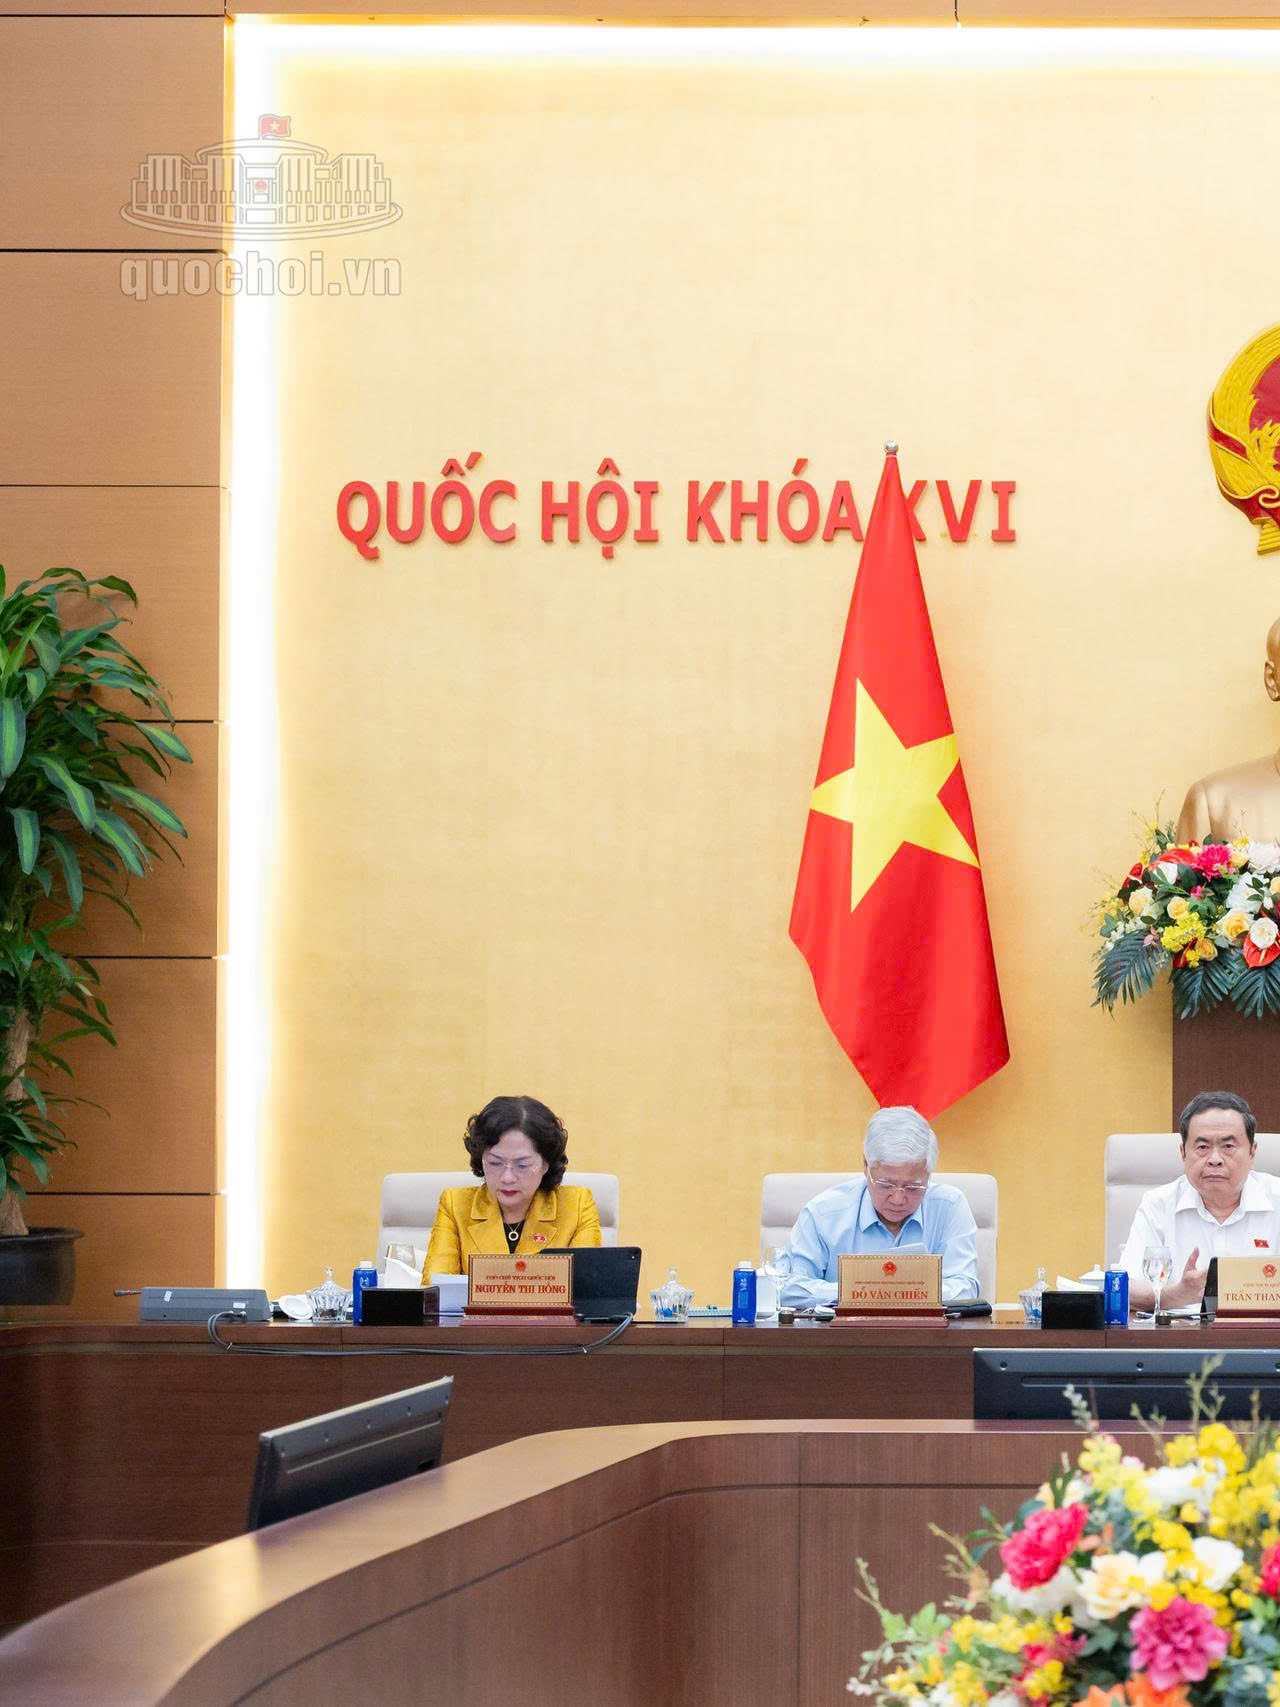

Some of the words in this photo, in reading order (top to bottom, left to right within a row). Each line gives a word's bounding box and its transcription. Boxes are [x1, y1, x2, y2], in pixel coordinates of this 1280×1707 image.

[337, 452, 518, 561] QUỐC
[541, 458, 660, 559] HỘI
[687, 458, 865, 545] KHÓA
